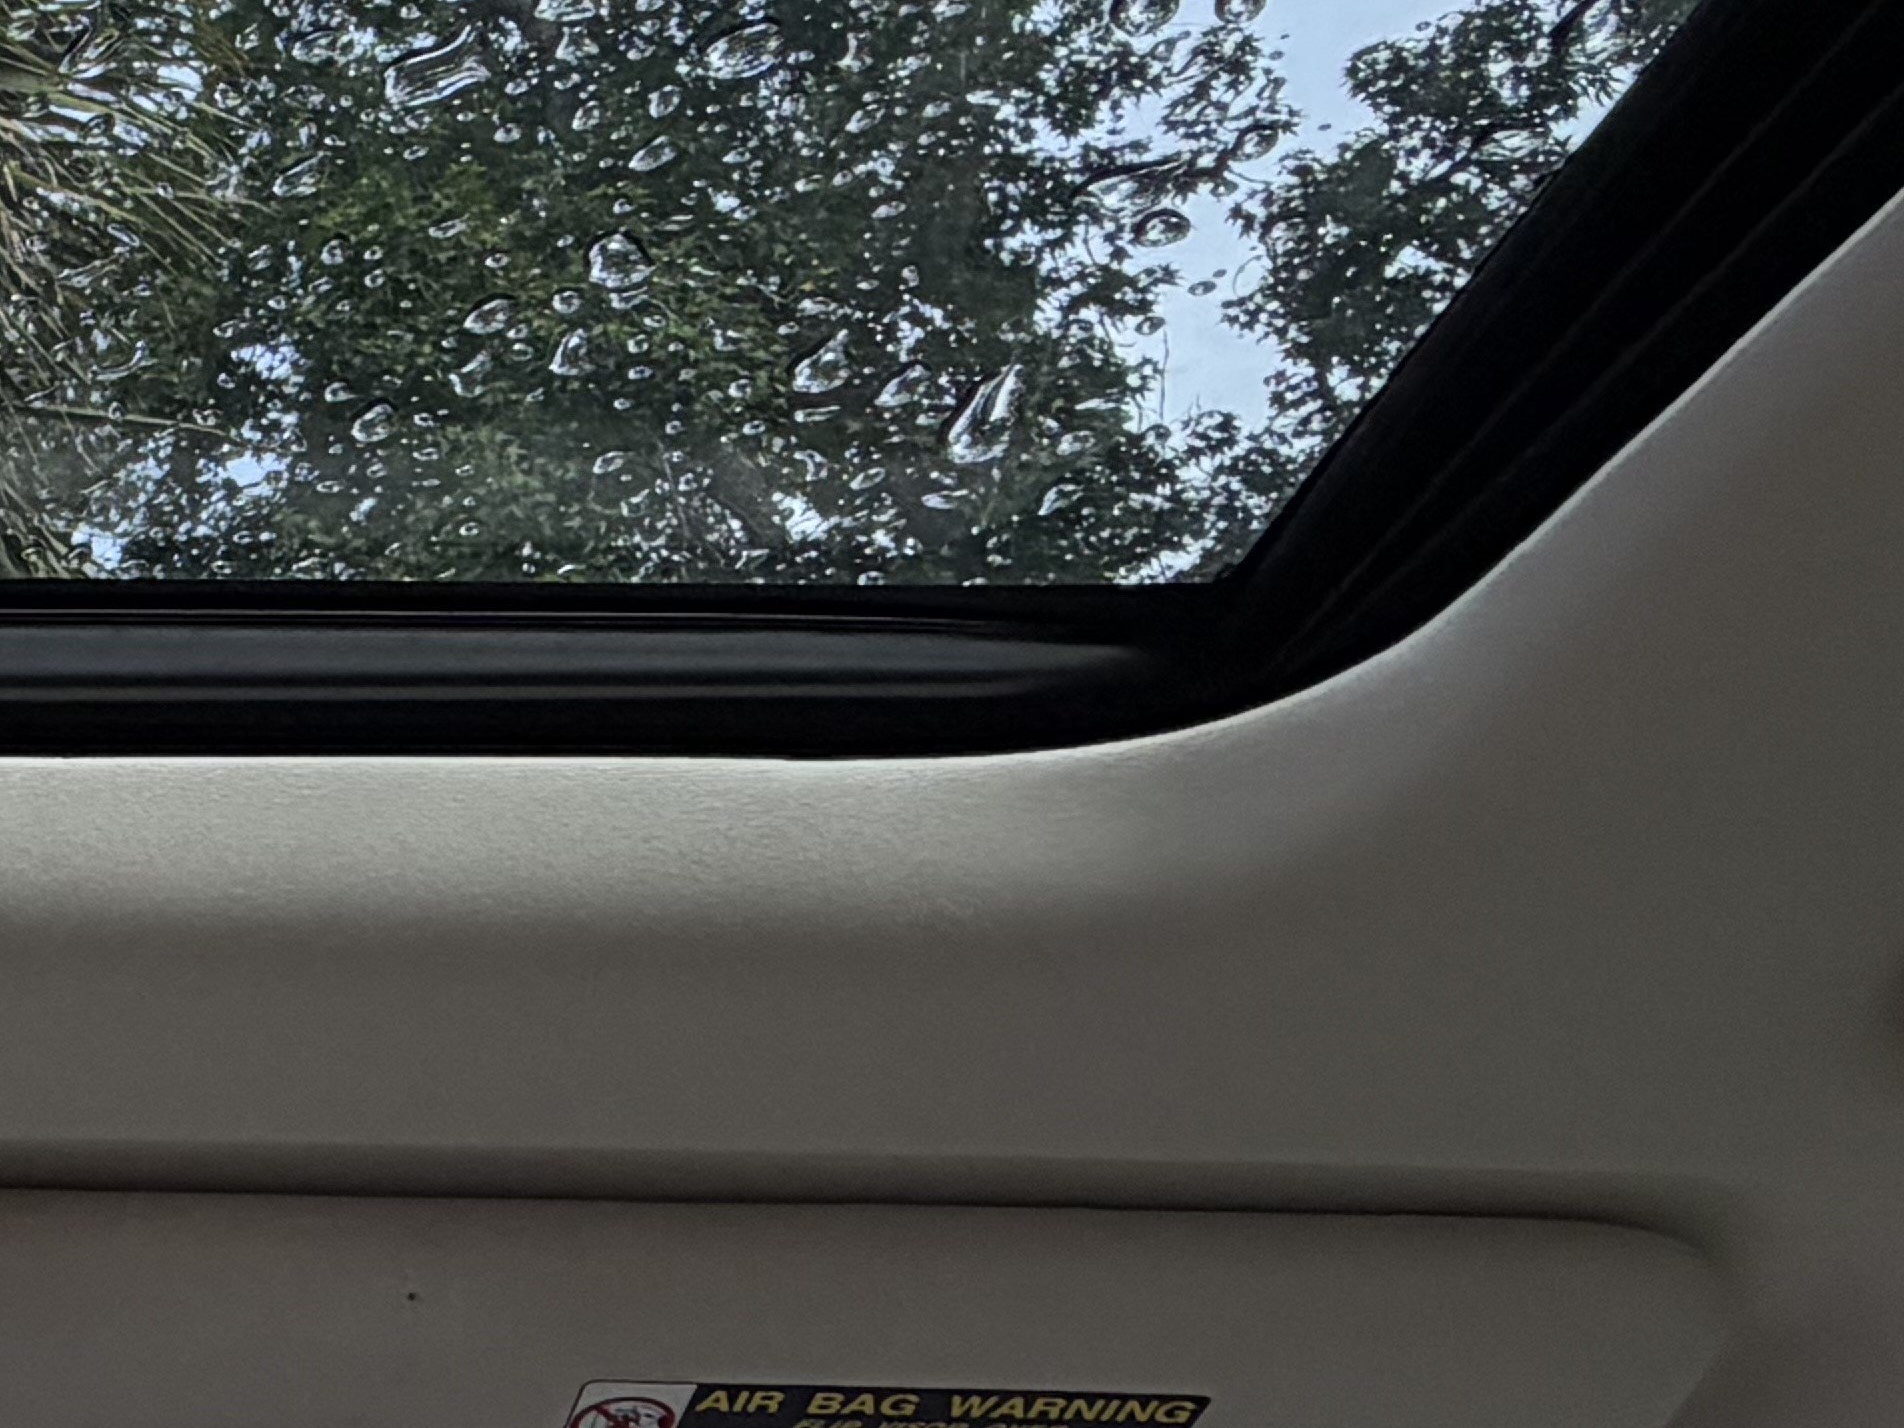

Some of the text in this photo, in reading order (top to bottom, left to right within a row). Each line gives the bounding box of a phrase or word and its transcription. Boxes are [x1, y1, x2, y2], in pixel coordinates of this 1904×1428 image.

[695, 1390, 1198, 1425] AIR BAG WARNING
